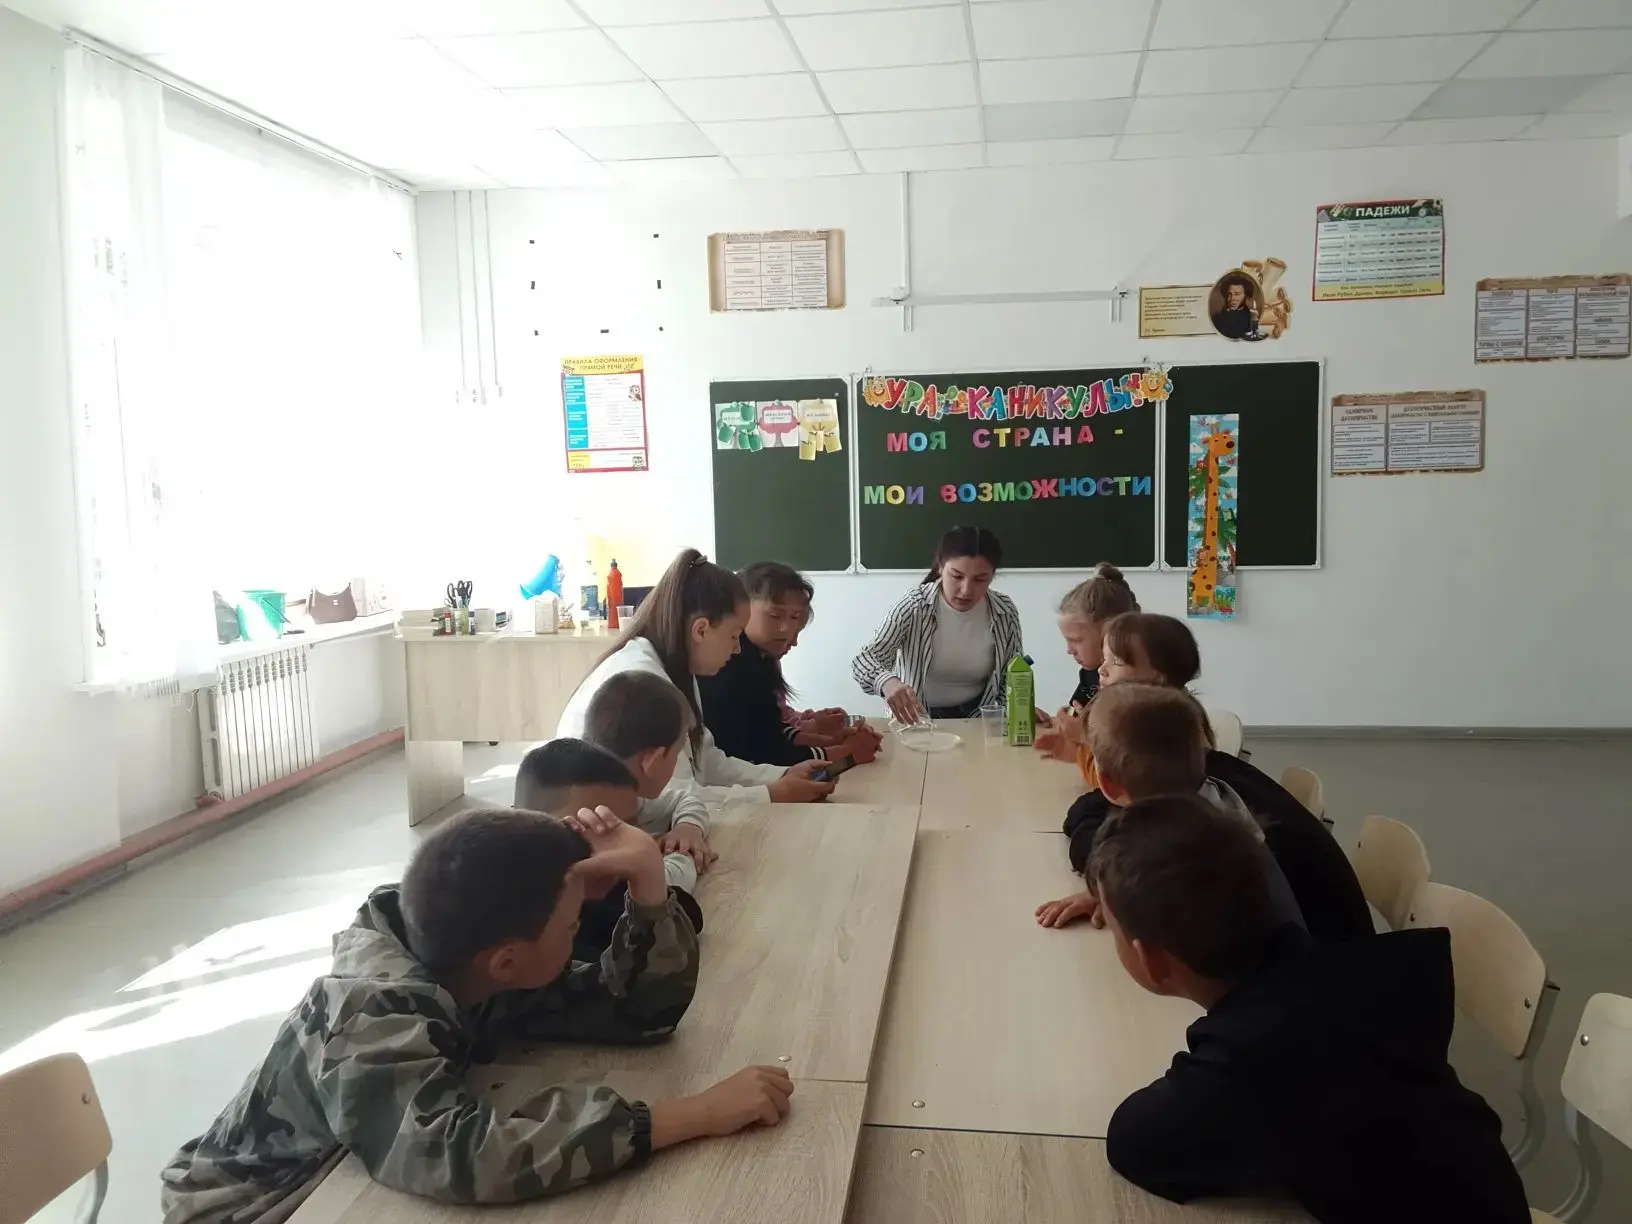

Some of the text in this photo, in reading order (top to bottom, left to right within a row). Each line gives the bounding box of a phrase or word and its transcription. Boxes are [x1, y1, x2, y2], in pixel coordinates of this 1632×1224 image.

[1355, 205, 1410, 217] ПАДЕЖИ
[887, 431, 946, 452] МОЯ
[973, 425, 1094, 448] СТРАНА
[864, 476, 1151, 505] МОИ ВОЗМОЖНОСТИ
